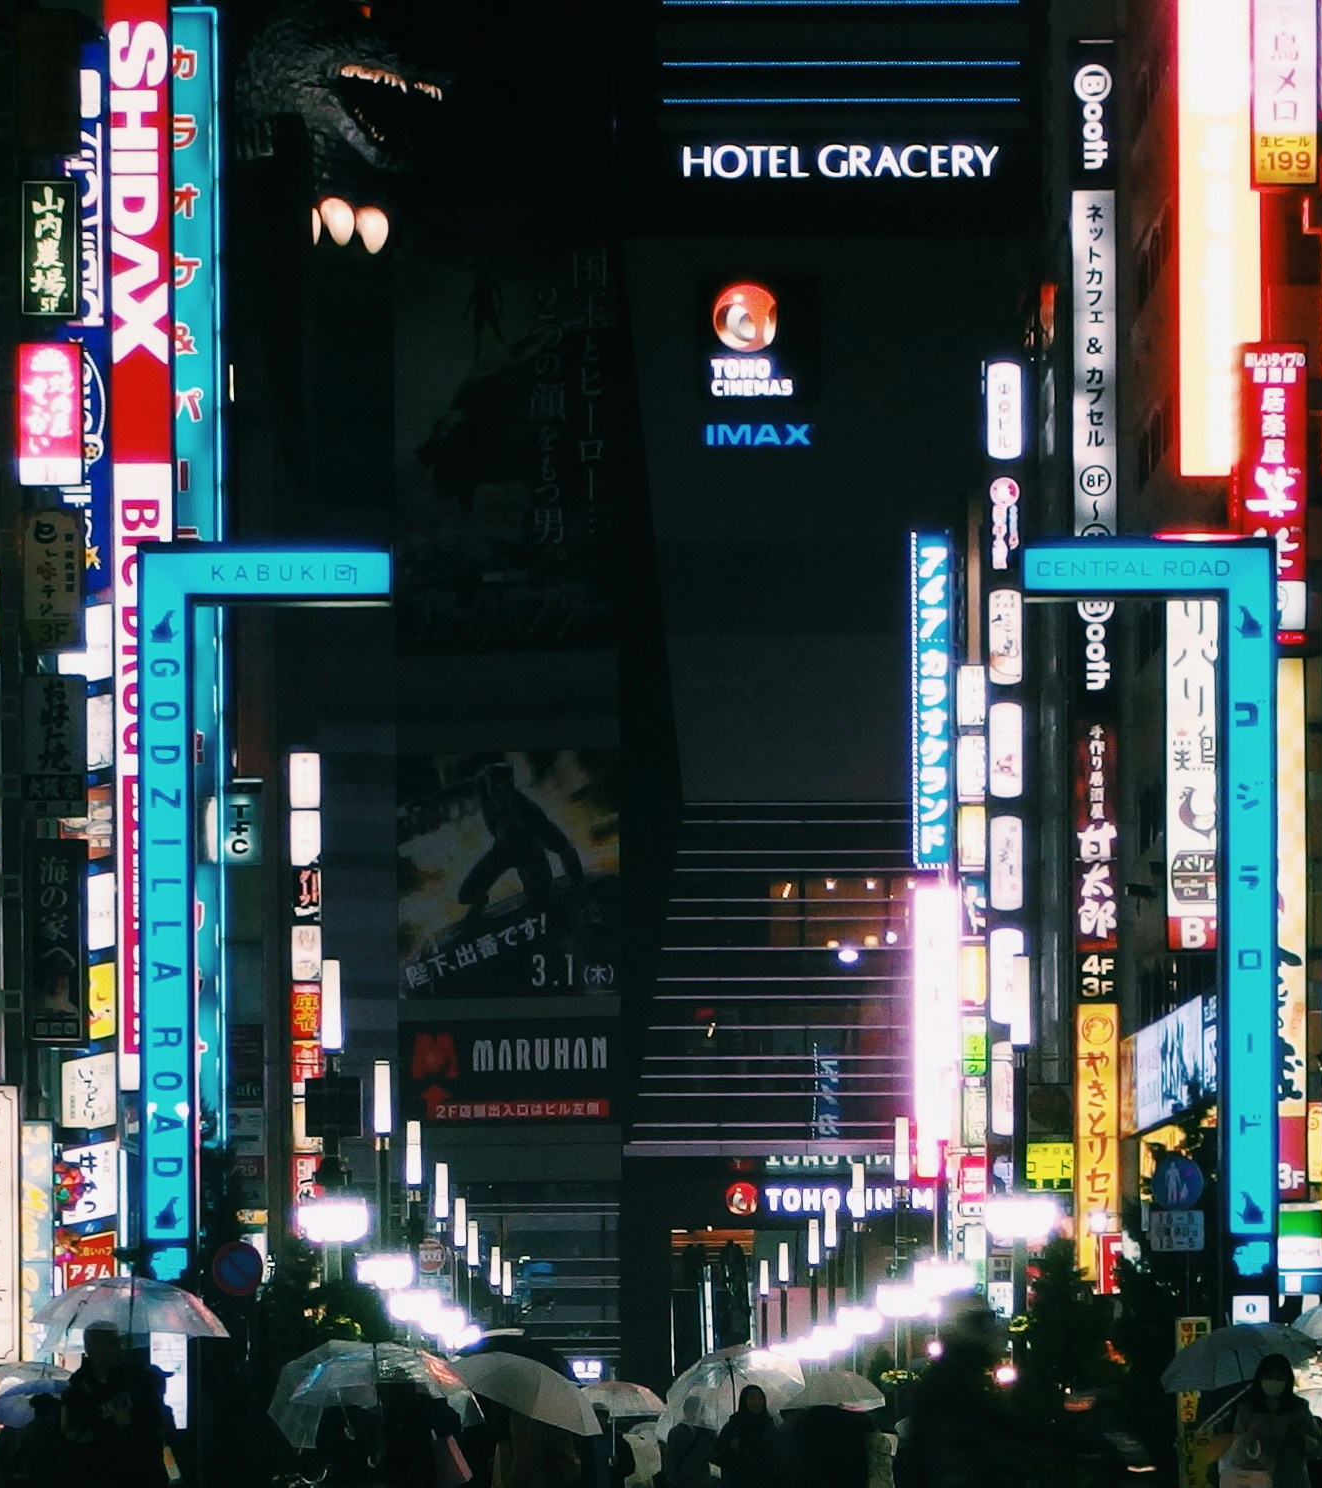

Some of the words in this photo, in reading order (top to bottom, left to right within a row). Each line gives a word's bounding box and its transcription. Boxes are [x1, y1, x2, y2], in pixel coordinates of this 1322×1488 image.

[1074, 64, 1113, 170] Booth
[682, 145, 809, 178] HOTEL
[818, 145, 999, 178] GRACERY
[1266, 151, 1312, 171] 199
[109, 20, 169, 365] SHIDAX
[711, 358, 771, 379] TOHO
[711, 379, 793, 397] CINEMAS
[706, 424, 810, 446] IMAX
[1262, 388, 1286, 464] 居楽屋
[1086, 473, 1105, 488] 8F
[1037, 561, 1153, 577] CENTRAL
[1164, 560, 1231, 577] ROAD
[149, 658, 181, 982] GODZILLA
[1077, 821, 1118, 939] 甘太郎
[39, 856, 71, 943] 海の家
[1082, 955, 1115, 975] 4F
[1082, 978, 1114, 999] 3F
[472, 1036, 608, 1072] MARUHAN
[149, 1027, 182, 1178] ROAD
[766, 1187, 838, 1212] TOHO
